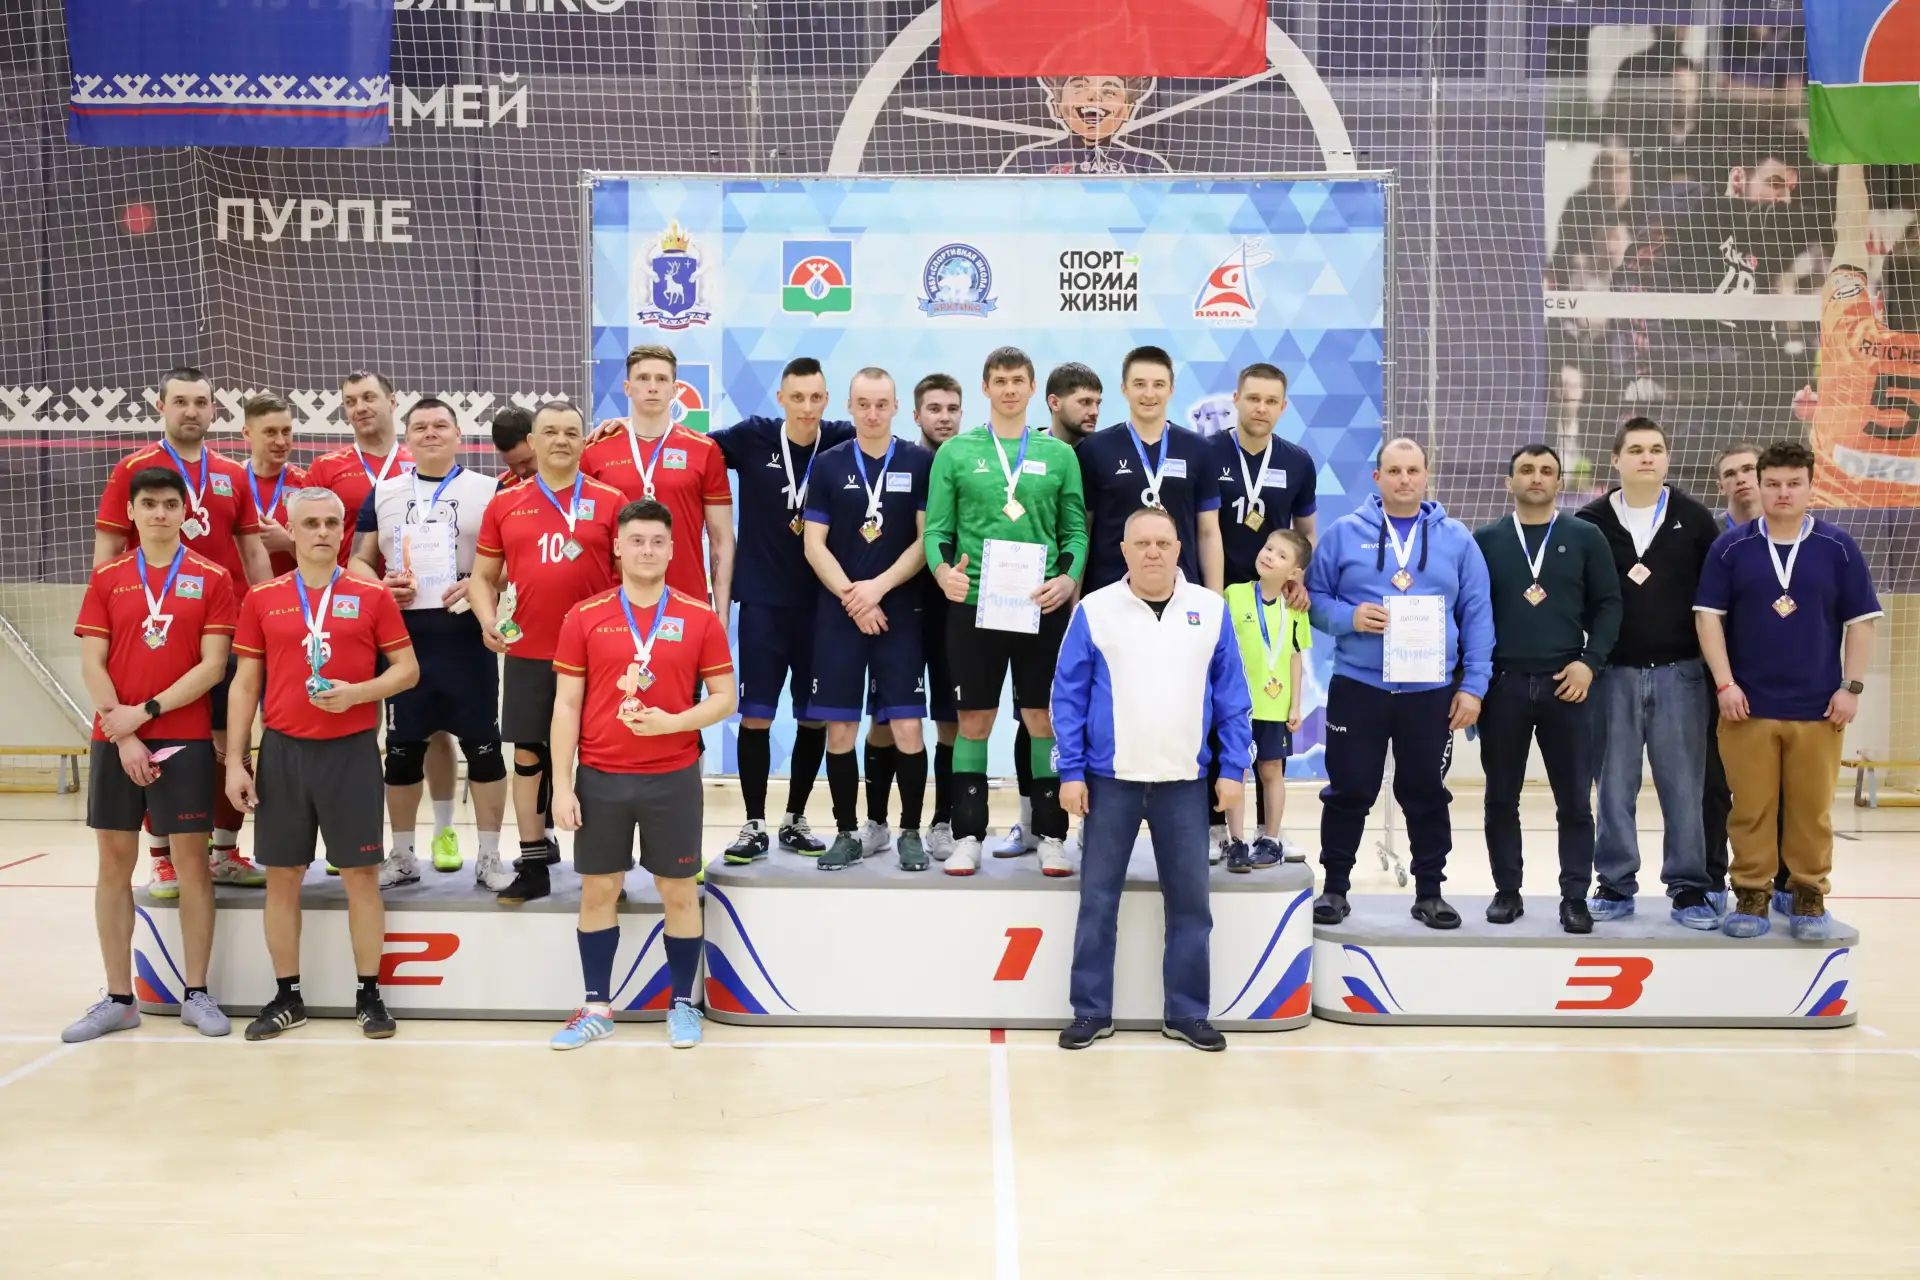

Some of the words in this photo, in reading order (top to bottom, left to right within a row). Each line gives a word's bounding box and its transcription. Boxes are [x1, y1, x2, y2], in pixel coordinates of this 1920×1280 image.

[216, 197, 413, 243] ПУРПЕ
[1059, 250, 1124, 270] СПОРТ
[1059, 272, 1138, 291] НОРМА
[933, 302, 981, 312] АРКТИКА
[1059, 292, 1138, 312] ЖИЗНИ
[1544, 298, 1578, 309] CEV
[1862, 372, 1920, 442] 5
[605, 458, 633, 466] KELME
[511, 508, 539, 516] KELME
[1231, 496, 1266, 524] 10
[537, 532, 564, 564] 10
[113, 583, 144, 594] KELME
[269, 606, 301, 616] KELME
[141, 614, 174, 646] 17
[300, 631, 331, 665] 15
[811, 677, 818, 694] 5
[954, 685, 961, 701] 1
[378, 932, 461, 986] 2
[993, 927, 1044, 981] 1
[1554, 956, 1654, 1011] 3
